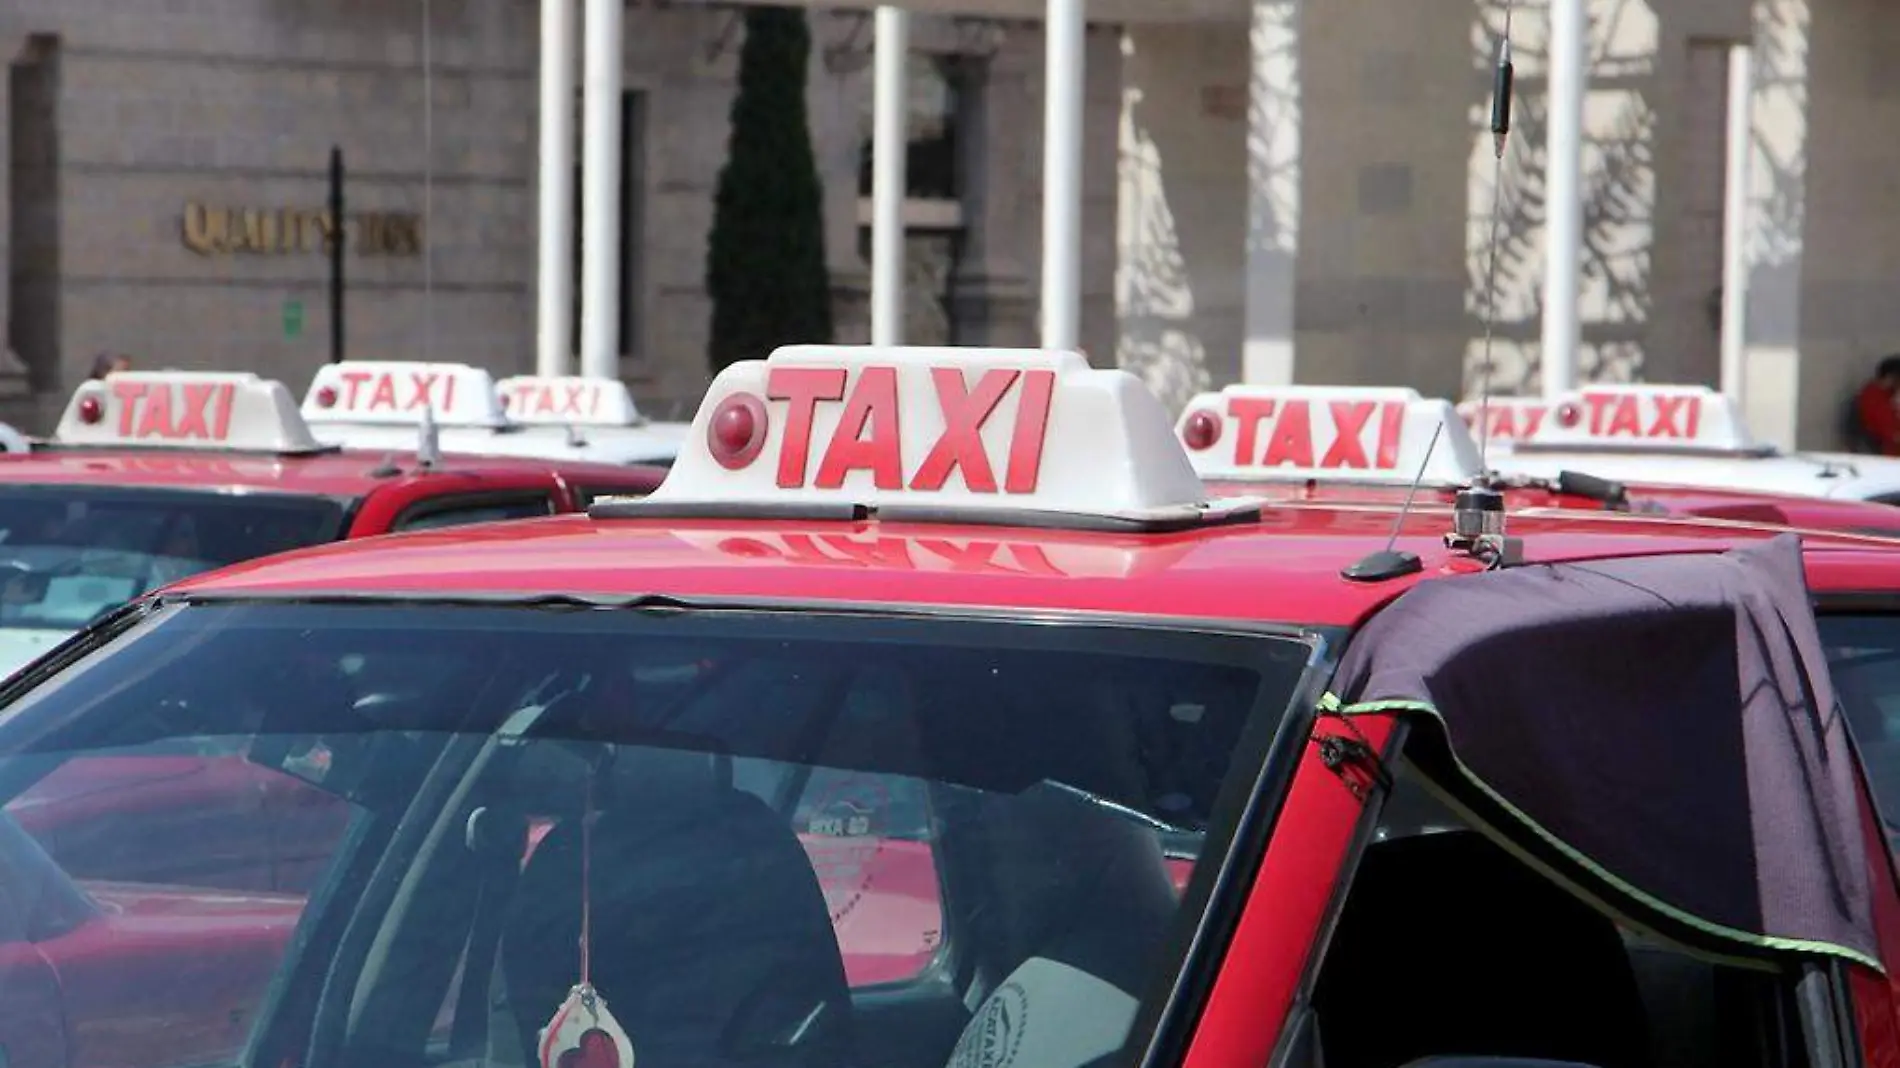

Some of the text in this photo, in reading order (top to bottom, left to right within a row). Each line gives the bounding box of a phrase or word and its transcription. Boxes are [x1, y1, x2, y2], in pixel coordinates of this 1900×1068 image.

[114, 382, 235, 441] TAXI
[340, 373, 456, 412] TAXI
[514, 385, 600, 414] TAXI
[766, 366, 1056, 494] TAXI
[1227, 398, 1405, 469] TAXI
[1475, 406, 1548, 438] TAX
[1582, 393, 1702, 438] TAXI
